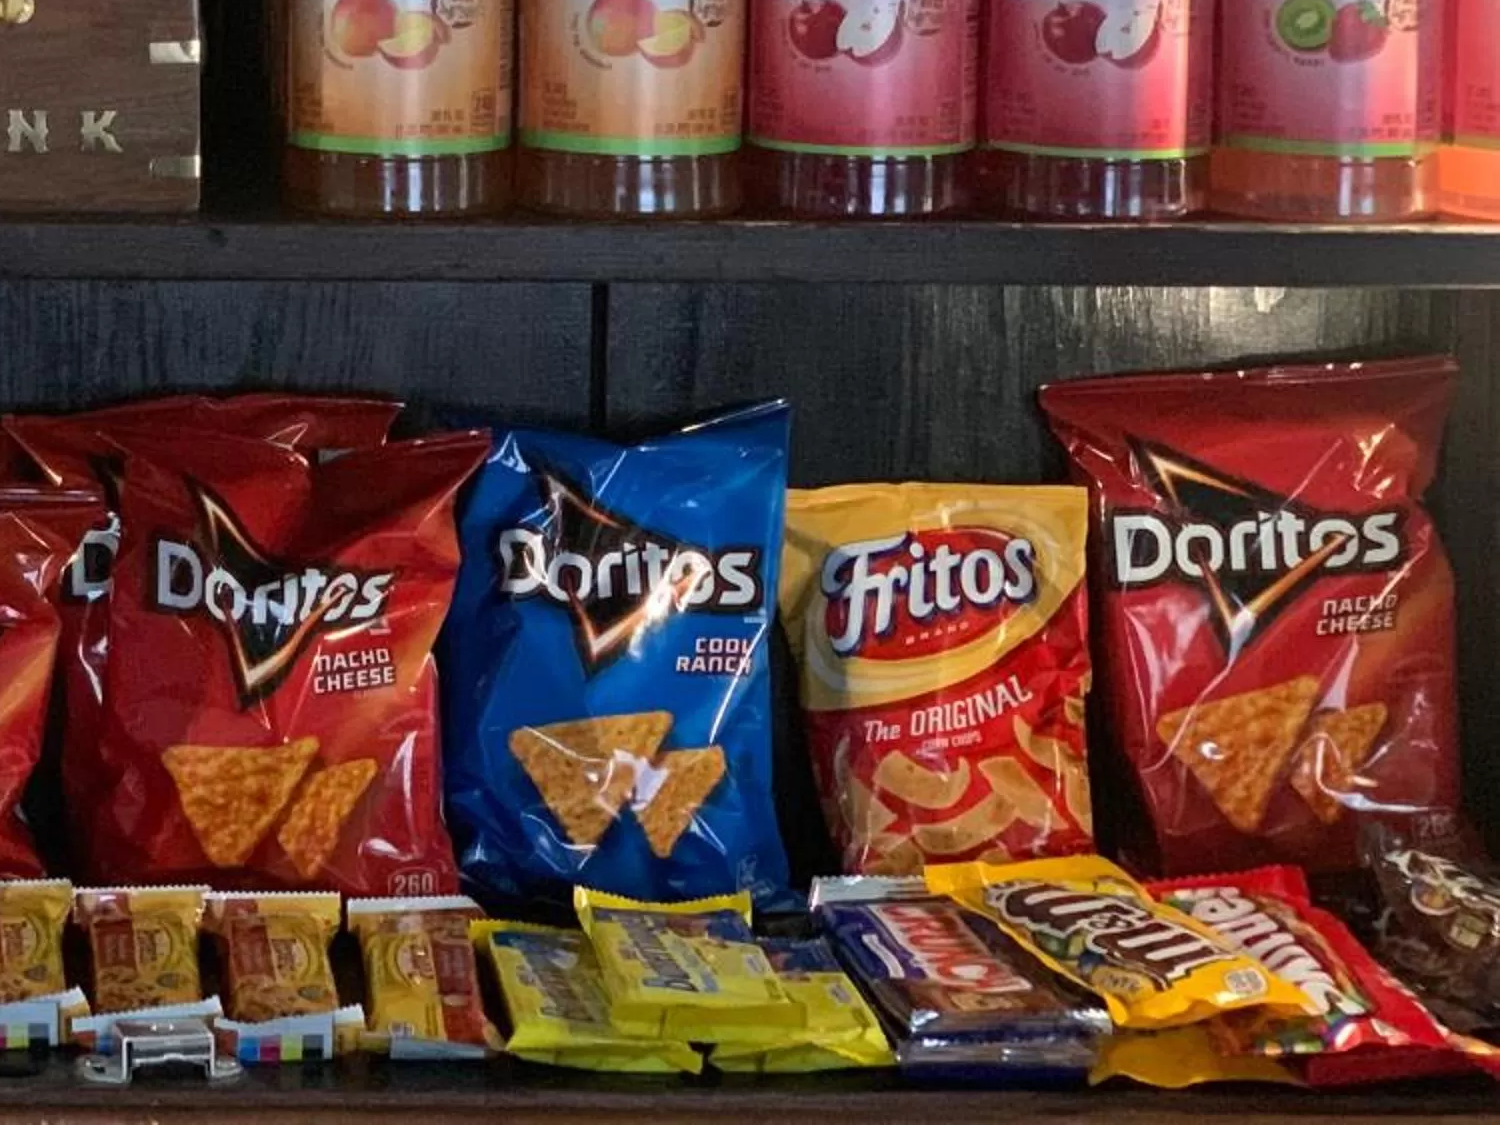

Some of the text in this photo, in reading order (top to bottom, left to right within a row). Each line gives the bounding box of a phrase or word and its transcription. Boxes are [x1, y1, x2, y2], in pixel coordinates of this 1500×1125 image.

[1113, 511, 1400, 583] Doritos
[500, 528, 756, 606] Doritos
[157, 539, 395, 626] Doritos
[822, 534, 1036, 654] Fritos
[1321, 595, 1397, 617] NACHO
[1315, 613, 1395, 636] CHEESE
[695, 637, 752, 654] COOL
[313, 648, 390, 674] NACHO
[675, 655, 752, 674] RANCH
[313, 666, 396, 693] CHEESE
[864, 675, 1033, 744] The ORIGINAL
[392, 873, 433, 896] 260
